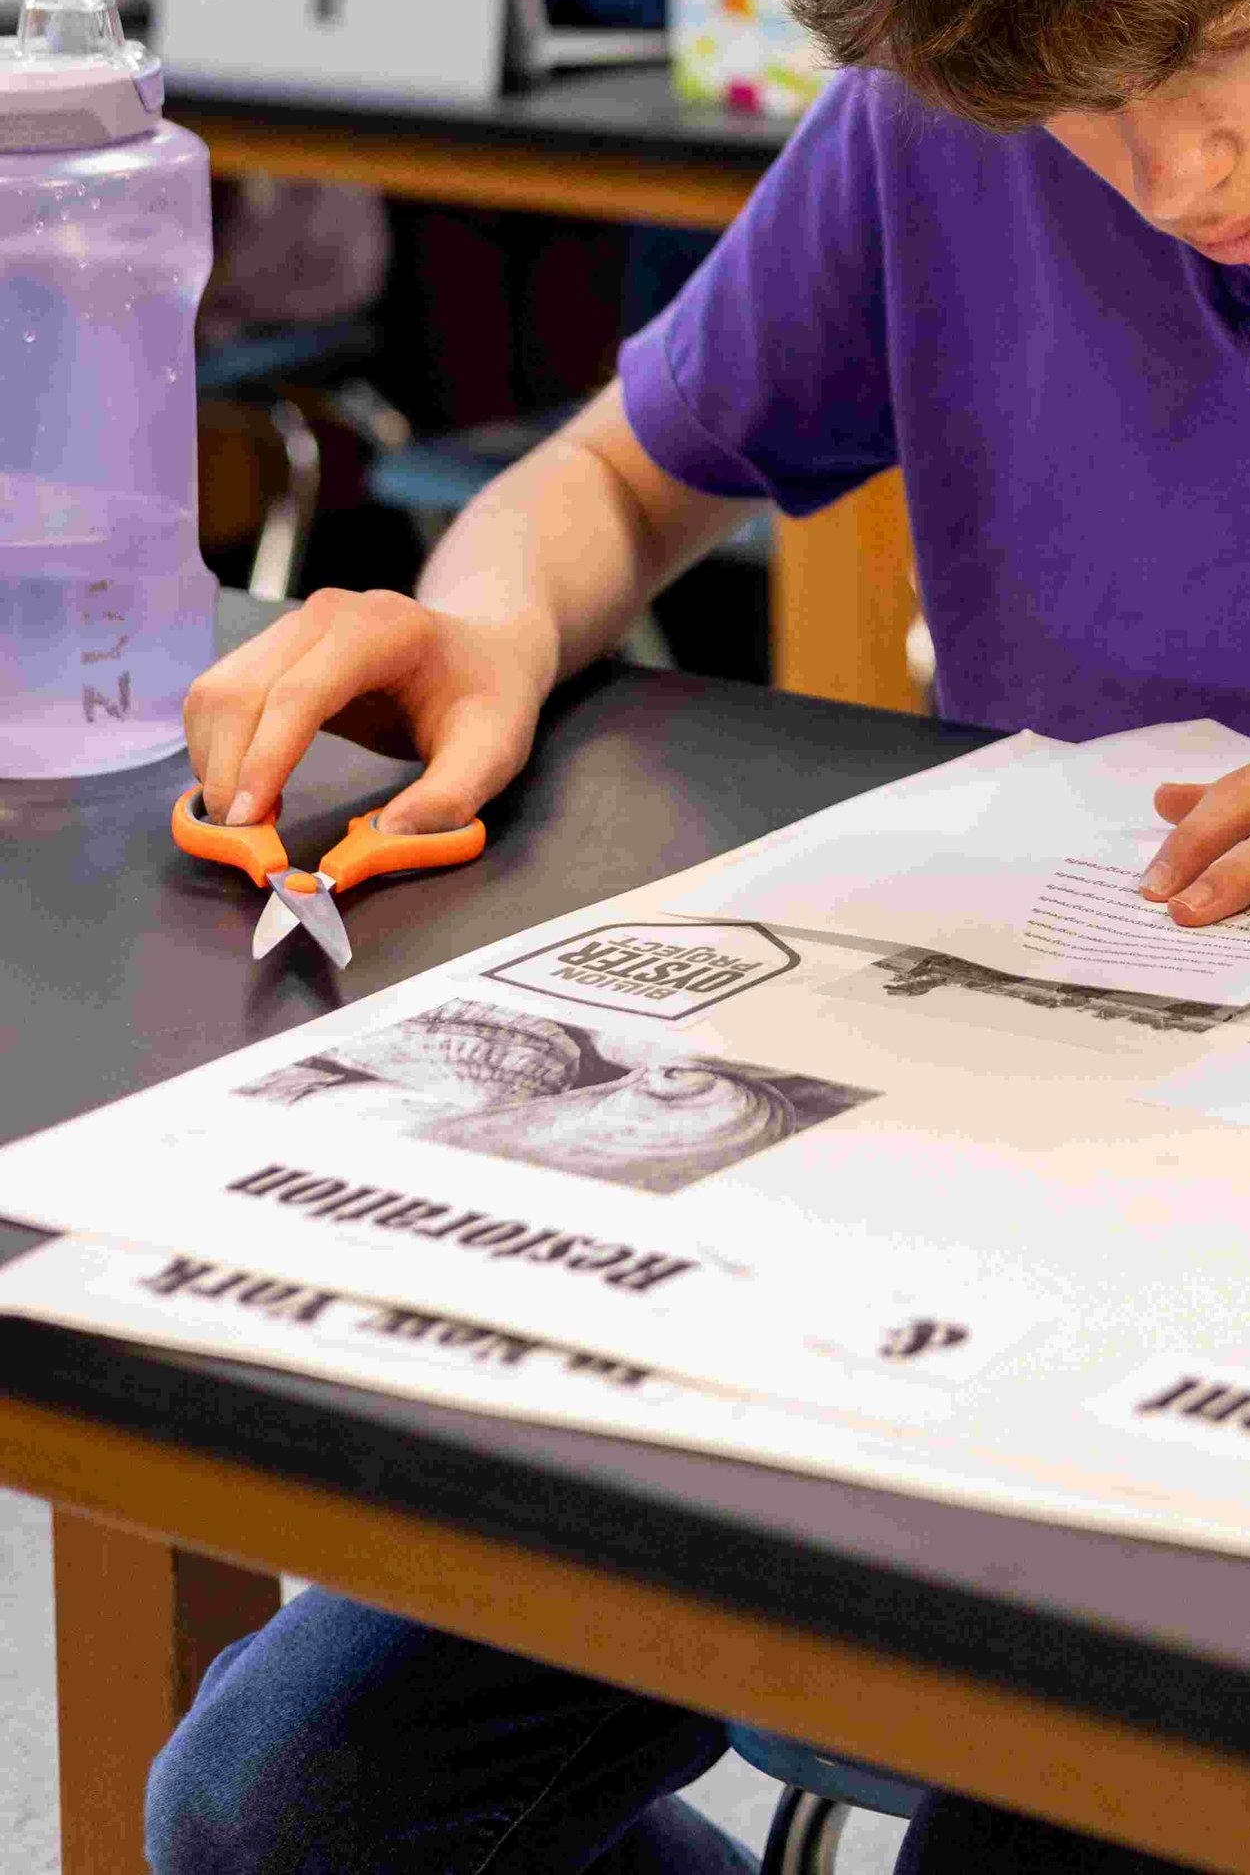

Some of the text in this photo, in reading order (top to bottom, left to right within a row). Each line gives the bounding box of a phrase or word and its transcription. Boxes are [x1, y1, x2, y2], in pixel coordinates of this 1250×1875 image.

[557, 941, 745, 994] OYSTER
[607, 937, 763, 972] PROJECT
[550, 966, 677, 1001] BILLION
[225, 1163, 698, 1295] Restoration
[137, 1256, 340, 1328] York
[879, 1319, 970, 1363] &
